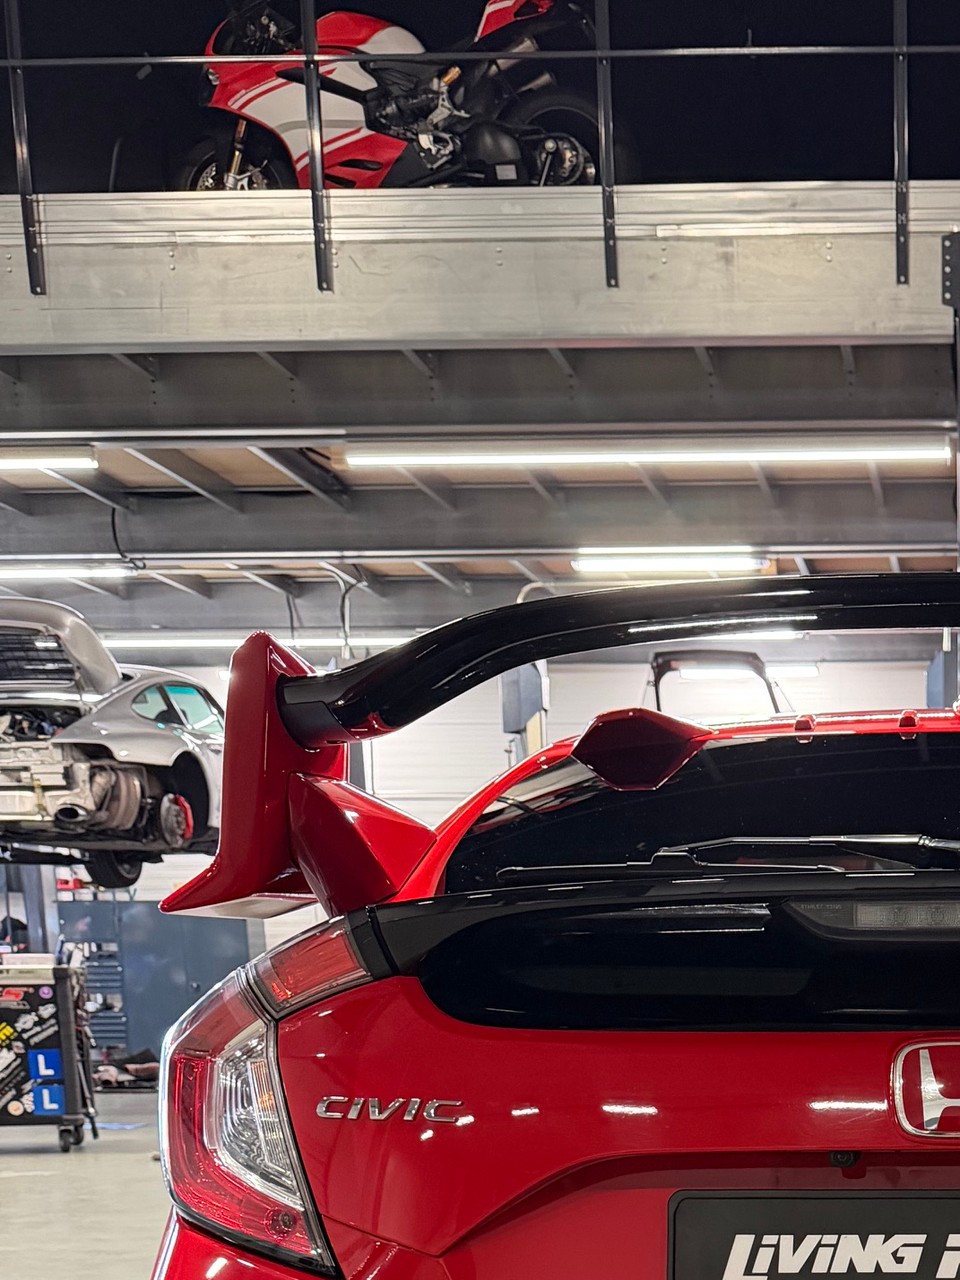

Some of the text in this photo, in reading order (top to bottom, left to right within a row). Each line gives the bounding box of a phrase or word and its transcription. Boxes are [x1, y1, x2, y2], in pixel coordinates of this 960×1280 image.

[37, 1054, 55, 1076] L
[42, 1088, 59, 1110] L
[315, 1095, 463, 1122] CIVIC
